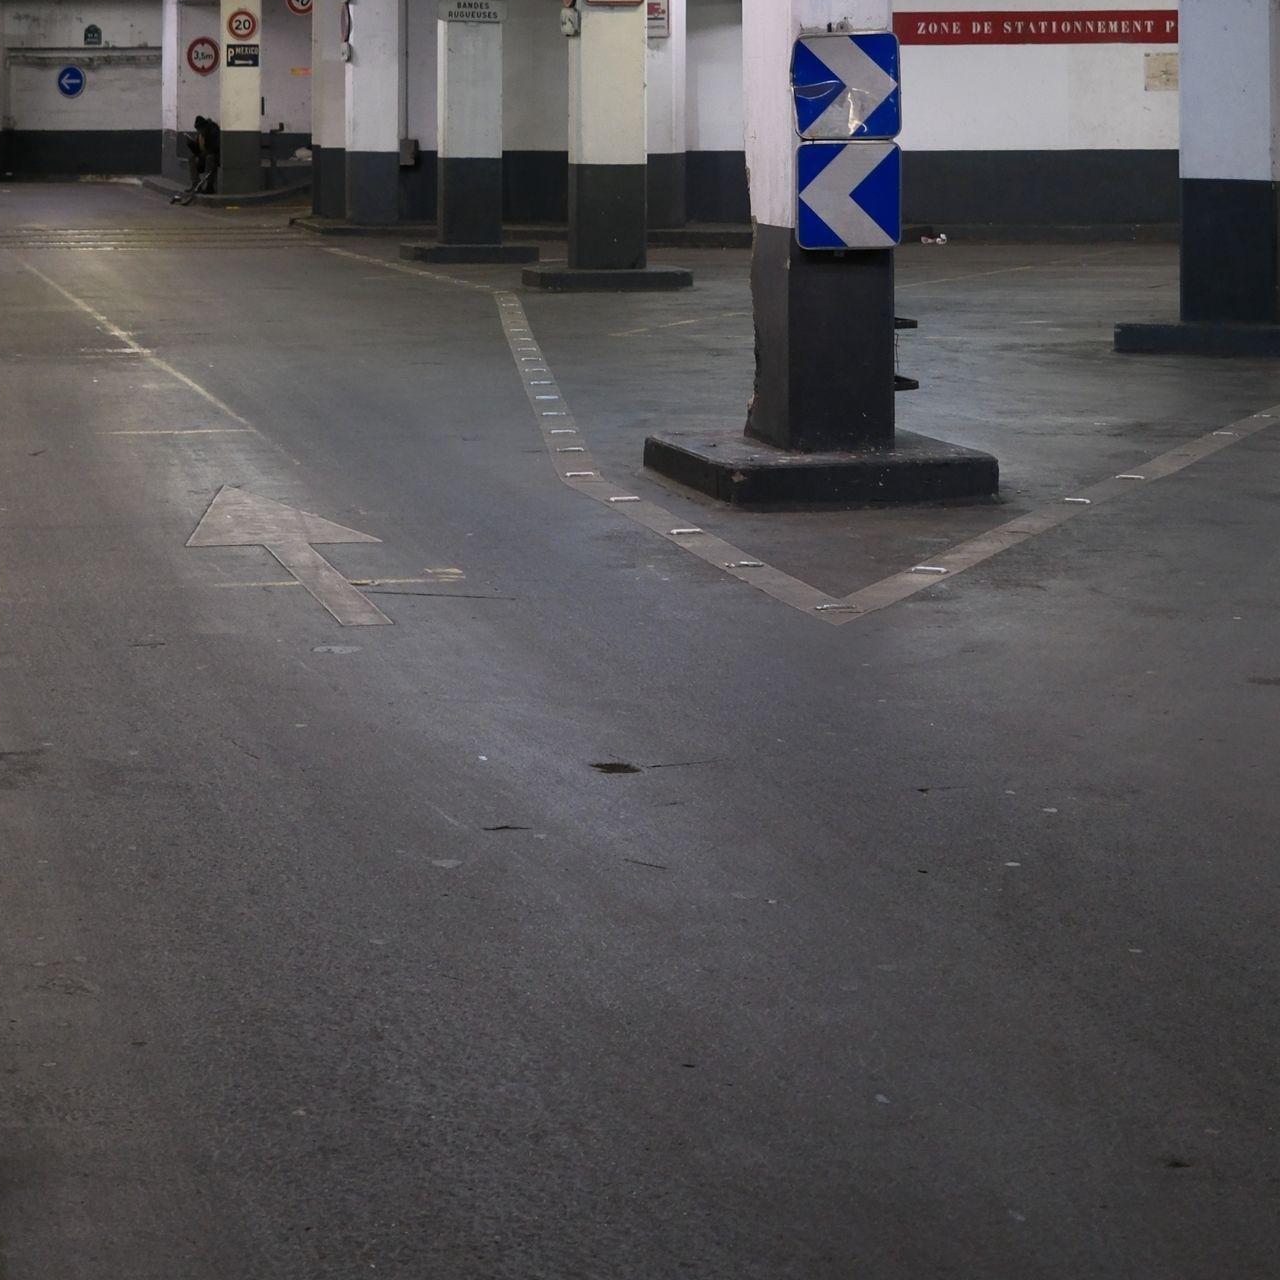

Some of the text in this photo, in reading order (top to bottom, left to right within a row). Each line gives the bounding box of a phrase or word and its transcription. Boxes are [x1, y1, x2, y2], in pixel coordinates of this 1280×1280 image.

[448, 10, 498, 19] RUGUEUSES
[234, 19, 251, 30] 20
[917, 21, 961, 35] ZONE
[972, 21, 992, 35] DE
[1003, 20, 1154, 35] STATIONNEMENT
[236, 46, 259, 55] MEXICO
